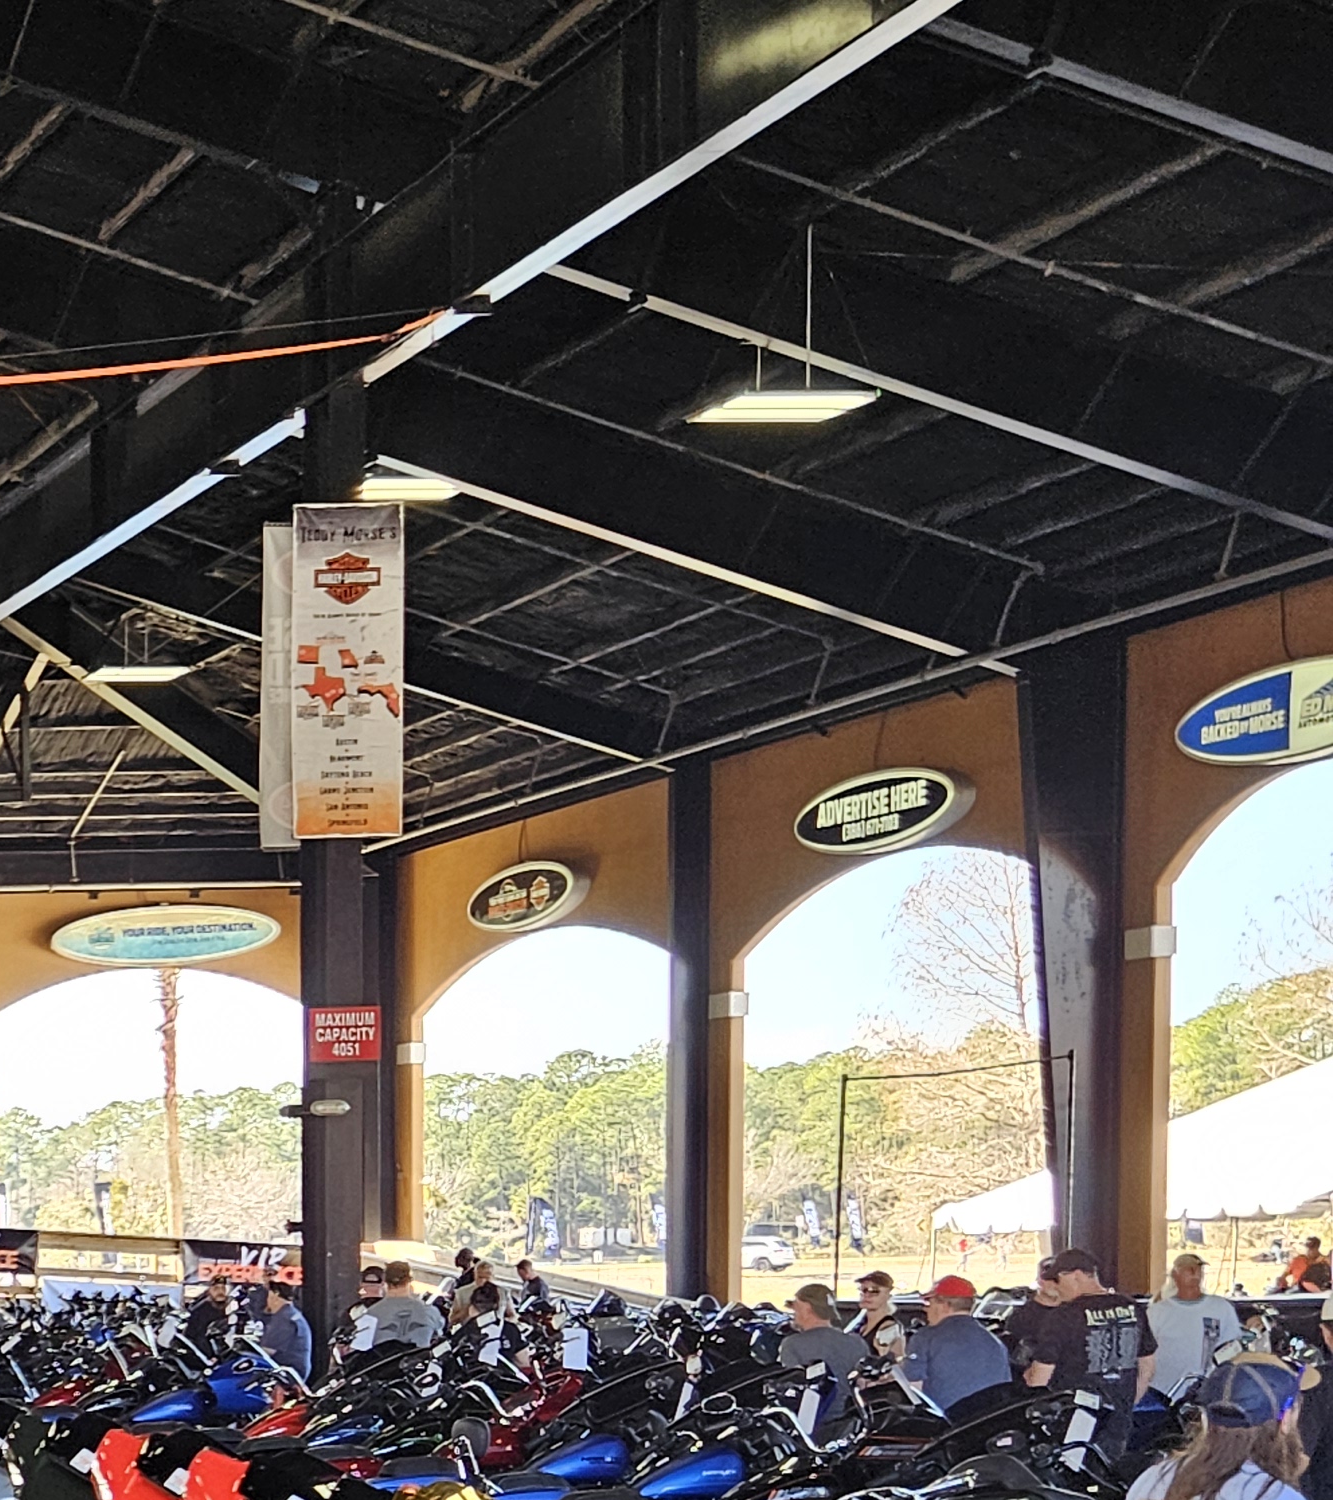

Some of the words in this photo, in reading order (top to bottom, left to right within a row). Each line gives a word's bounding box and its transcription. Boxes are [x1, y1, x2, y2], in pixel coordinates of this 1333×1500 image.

[1301, 697, 1323, 719] ED
[1201, 719, 1239, 745] BACKED
[1249, 710, 1286, 735] MORSE
[817, 787, 890, 829] ADVERTISE
[890, 780, 929, 812] HERE
[122, 929, 147, 938] YOUR
[171, 926, 195, 935] YOUR
[315, 1012, 375, 1026] MAXIMUM
[316, 1027, 375, 1042] CAPACITY
[332, 1043, 360, 1056] 4051
[241, 1246, 288, 1271] VIP
